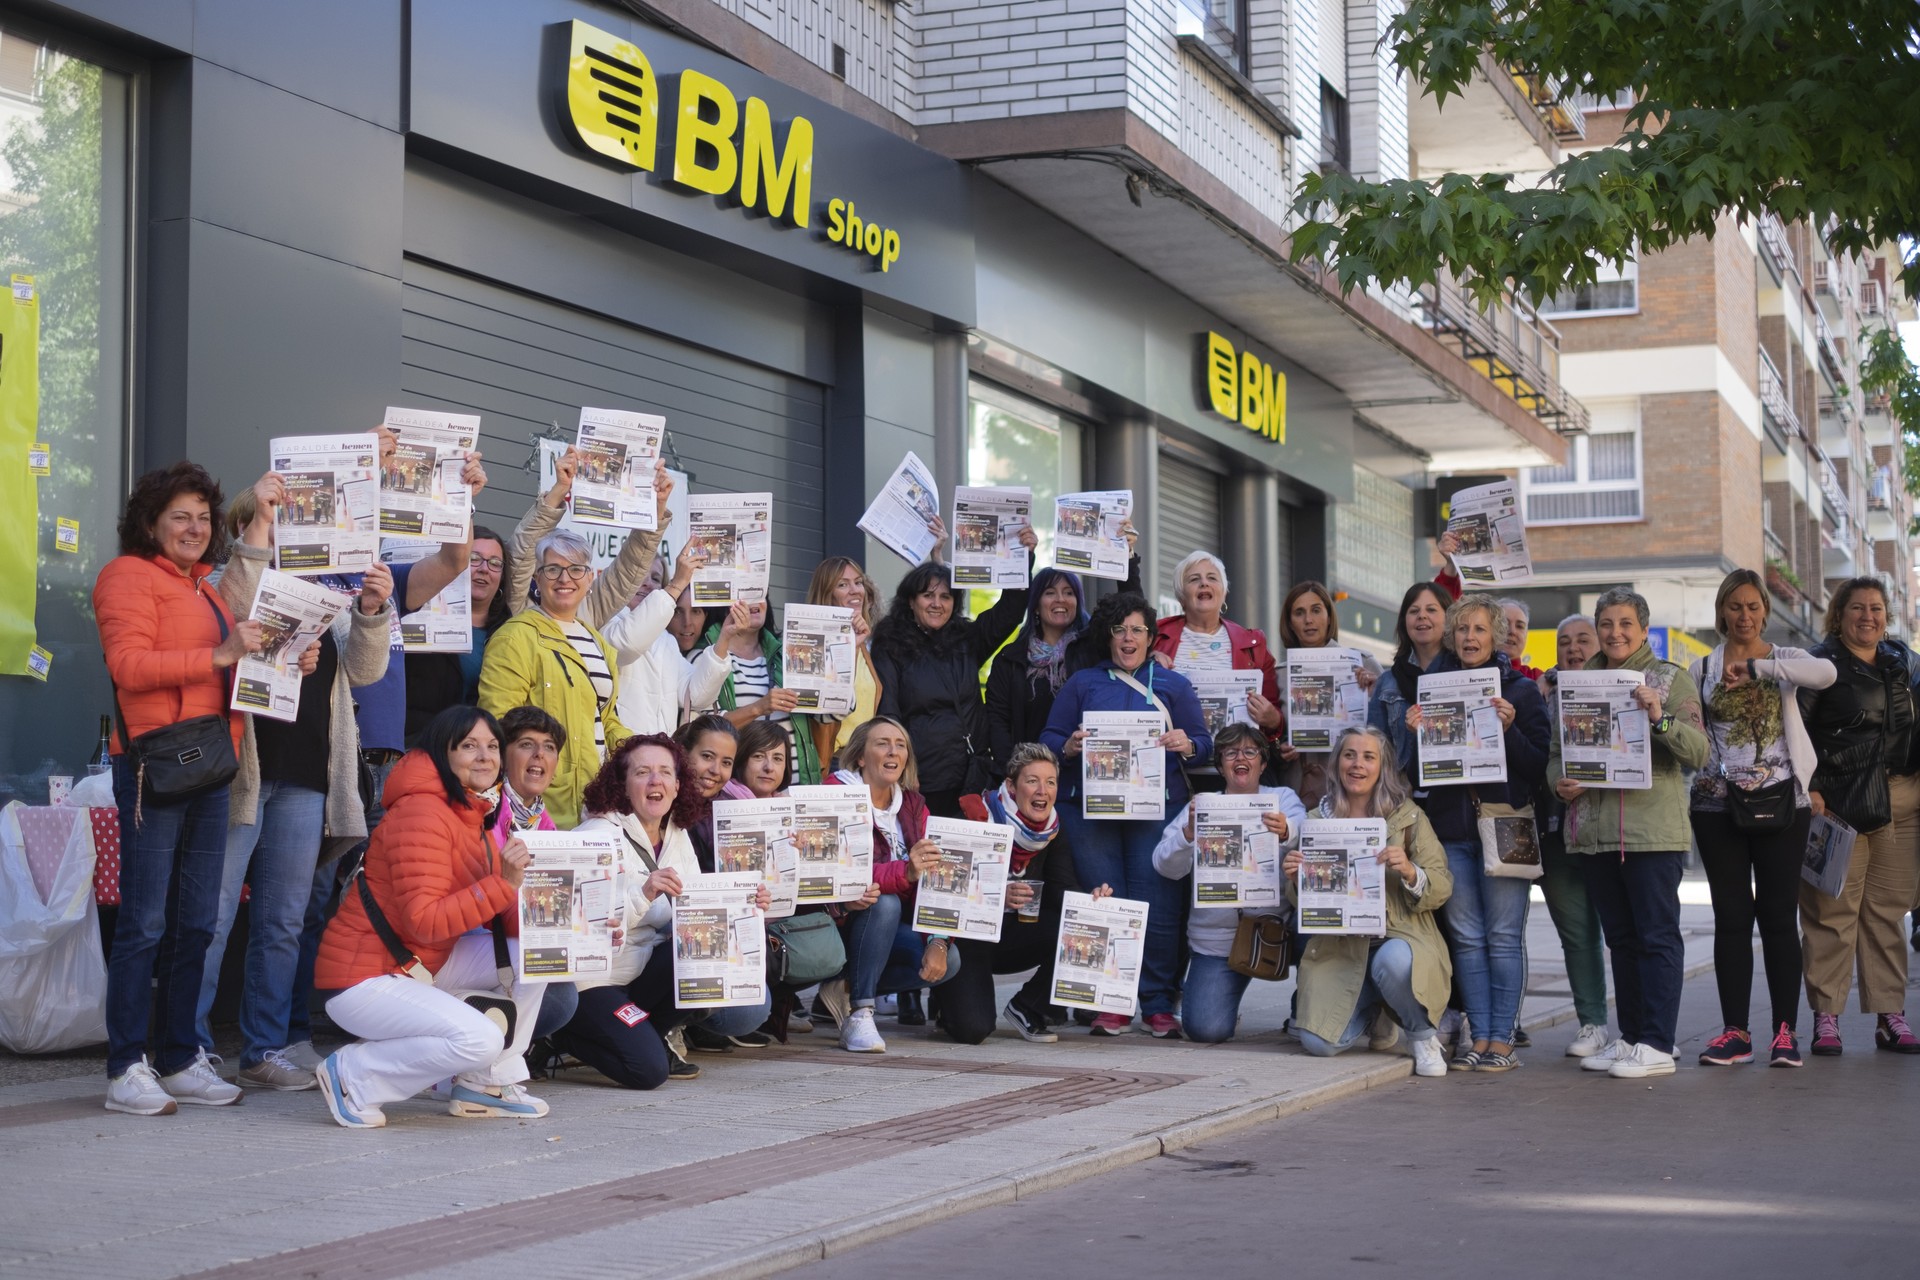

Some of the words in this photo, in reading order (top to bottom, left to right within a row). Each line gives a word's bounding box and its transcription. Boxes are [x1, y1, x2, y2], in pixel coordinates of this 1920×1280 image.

[674, 68, 814, 228] BM
[826, 198, 900, 273] Shop
[1242, 350, 1286, 446] BM
